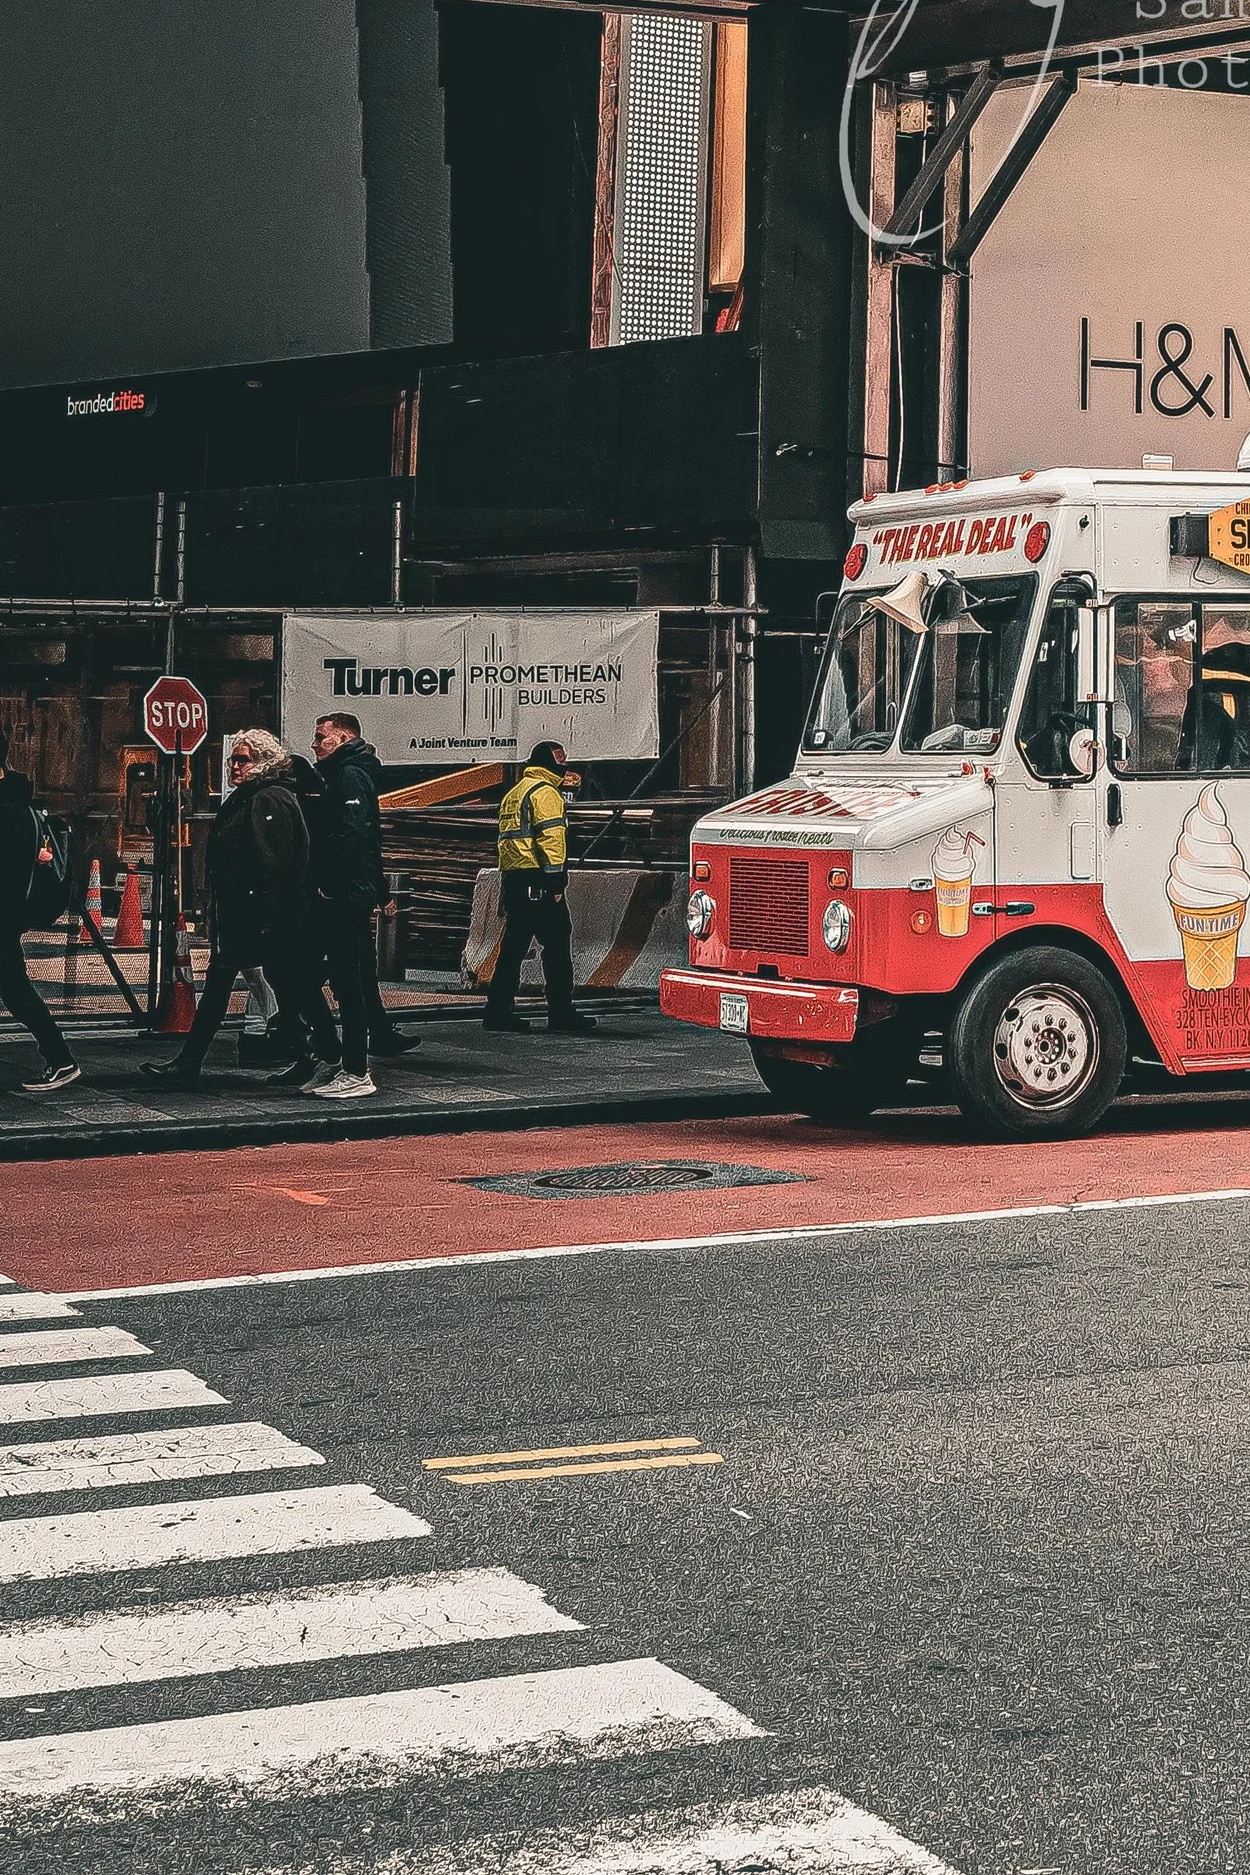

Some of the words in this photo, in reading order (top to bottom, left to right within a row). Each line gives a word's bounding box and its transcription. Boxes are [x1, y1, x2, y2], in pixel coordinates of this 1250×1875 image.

[67, 390, 145, 416] brandedcities
[914, 519, 966, 562] REAL
[323, 658, 456, 696] Turner
[470, 664, 622, 684] PROMETHEAN
[518, 688, 606, 705] BUILDERS
[151, 700, 202, 728] STOP
[409, 738, 417, 749] A
[418, 737, 447, 749] Joint
[448, 736, 488, 748] Venture
[489, 736, 517, 747] Team
[1181, 987, 1241, 1009] SMOOTHIE
[1176, 1010, 1196, 1030] 328
